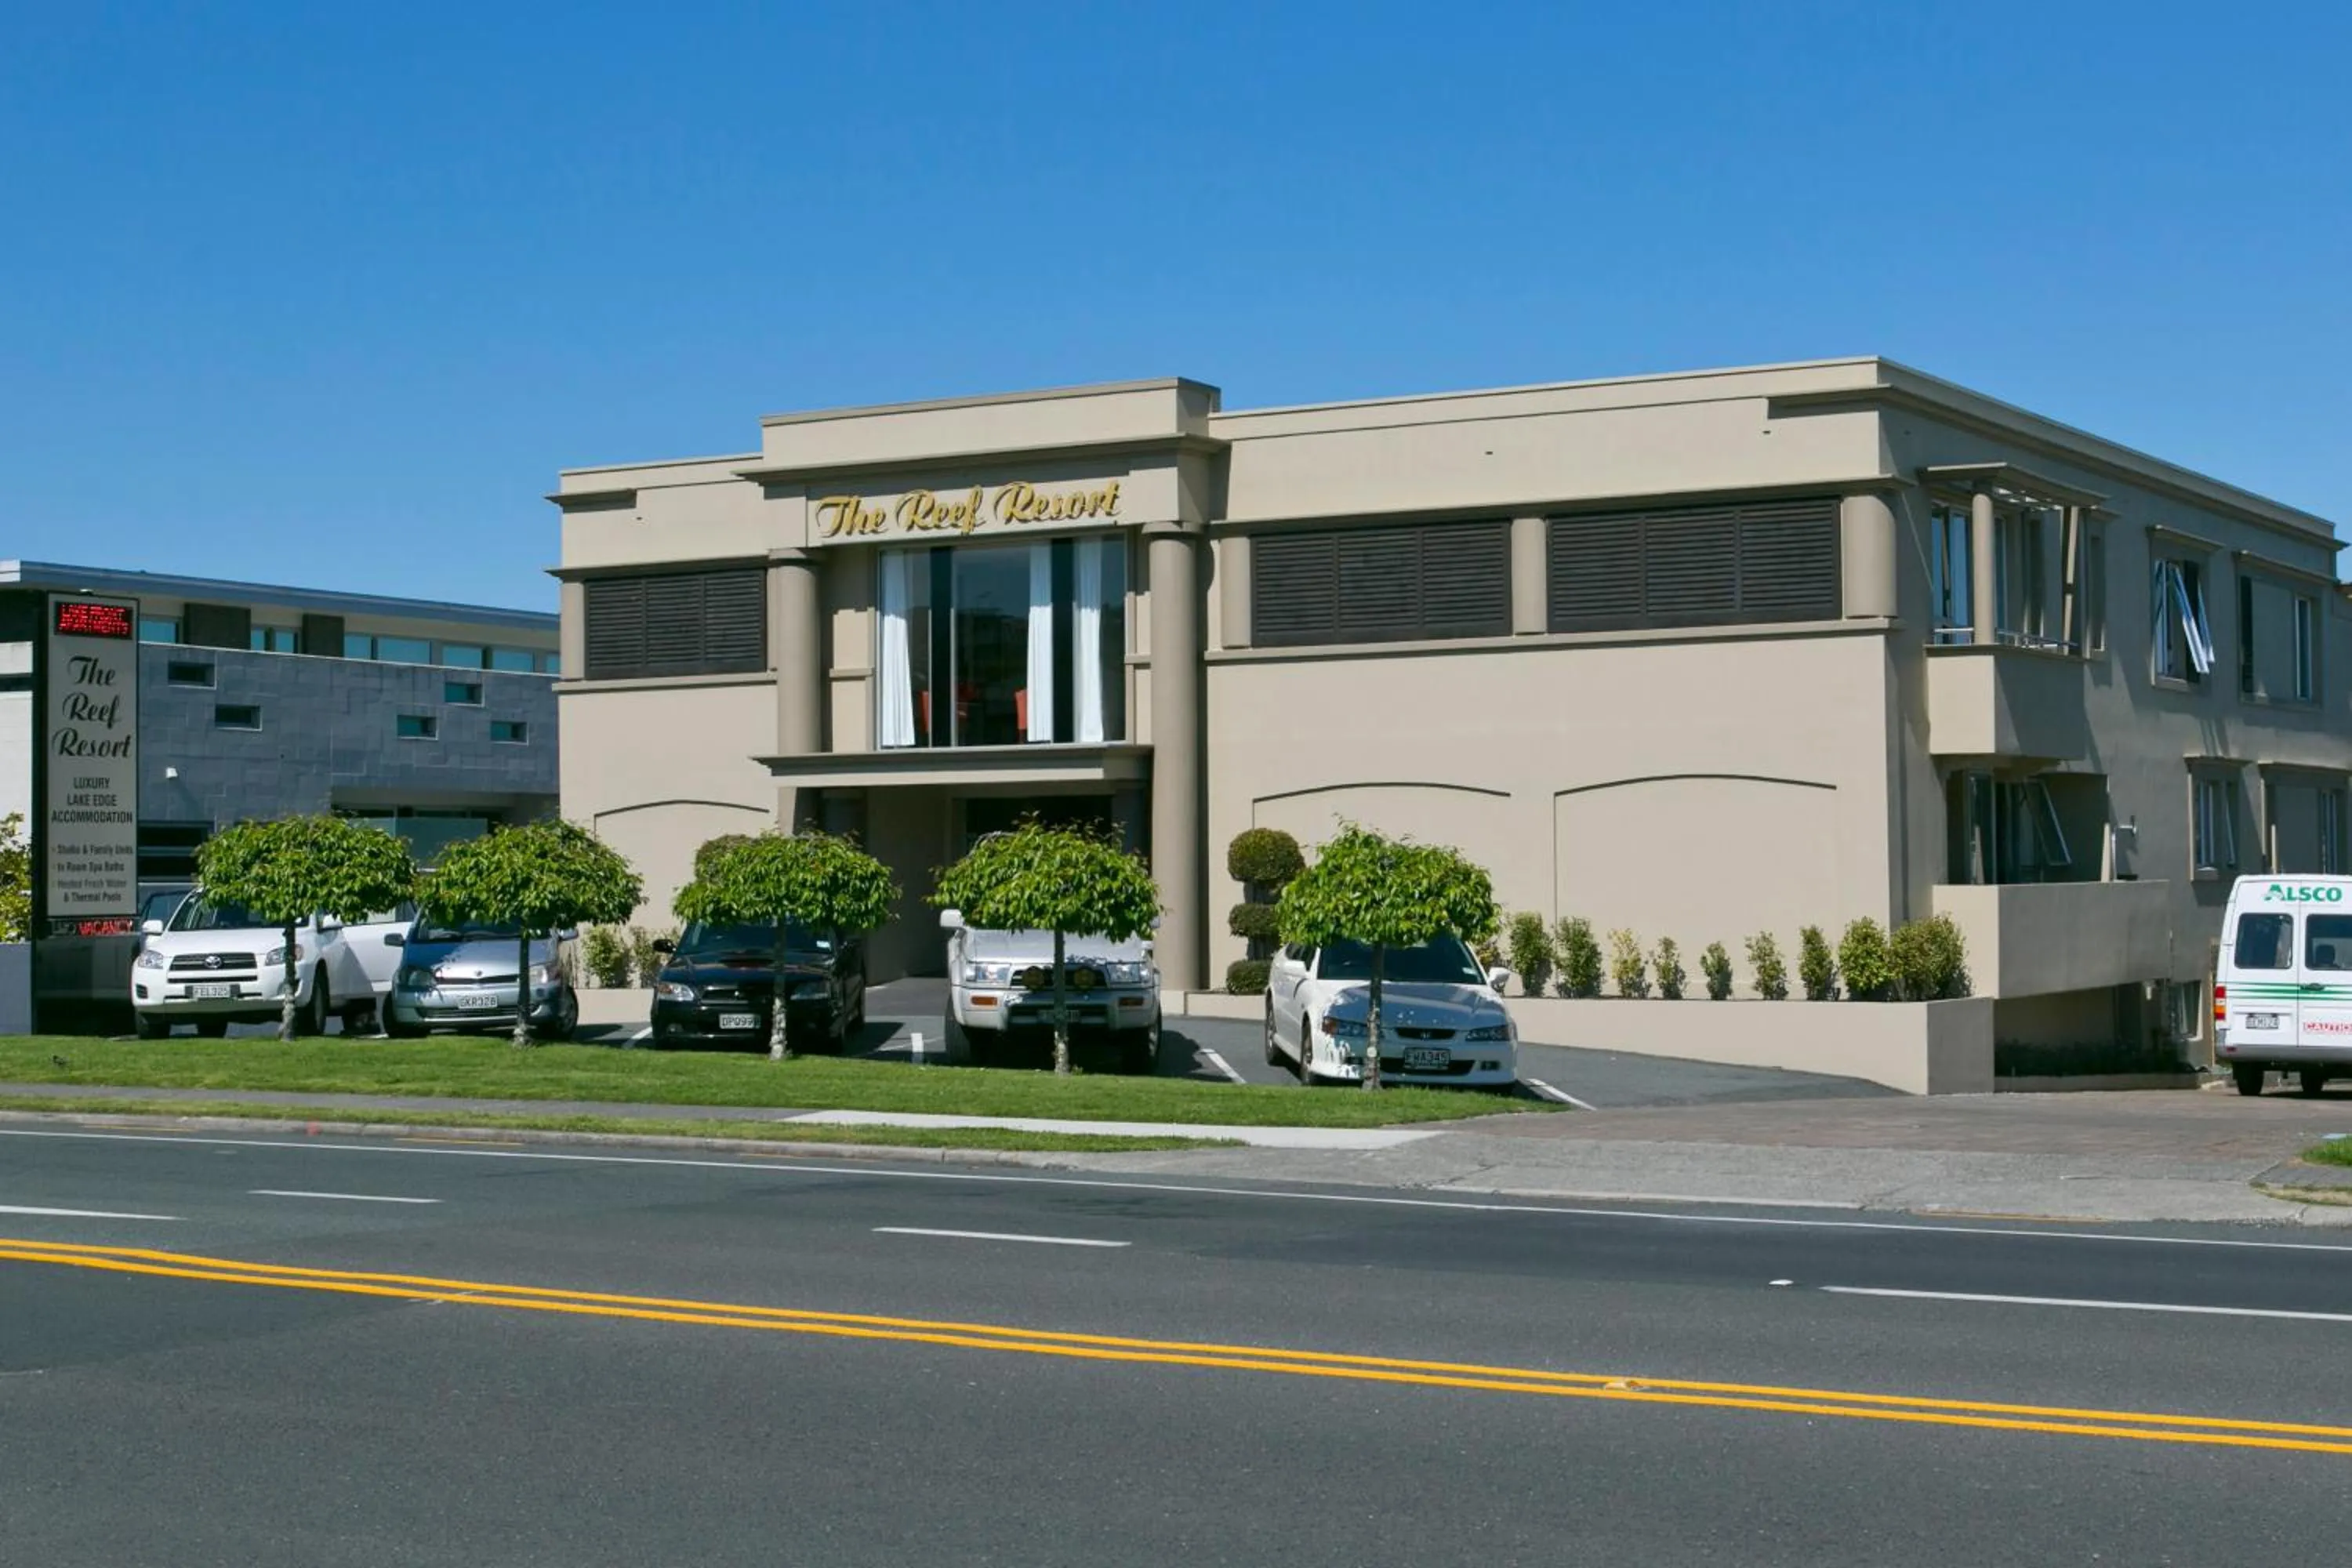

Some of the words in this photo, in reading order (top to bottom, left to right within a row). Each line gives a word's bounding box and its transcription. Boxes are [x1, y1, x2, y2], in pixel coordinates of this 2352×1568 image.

[815, 494, 889, 538] The
[895, 485, 986, 535] Reef
[993, 480, 1120, 525] Resort
[67, 655, 117, 686] The
[63, 692, 122, 730] Reef
[52, 727, 131, 758] Resort
[73, 777, 110, 789] LUXURY
[67, 793, 89, 806] LAKE
[93, 794, 117, 807] EDGE
[51, 809, 132, 824] ACCOMMODATION
[90, 844, 113, 856] Family
[67, 862, 87, 872] Room
[89, 862, 103, 873] Spa
[71, 892, 101, 902] Thermal
[103, 892, 122, 902] Pools
[2264, 884, 2343, 902] ALSCO
[78, 920, 133, 935] VACANCY
